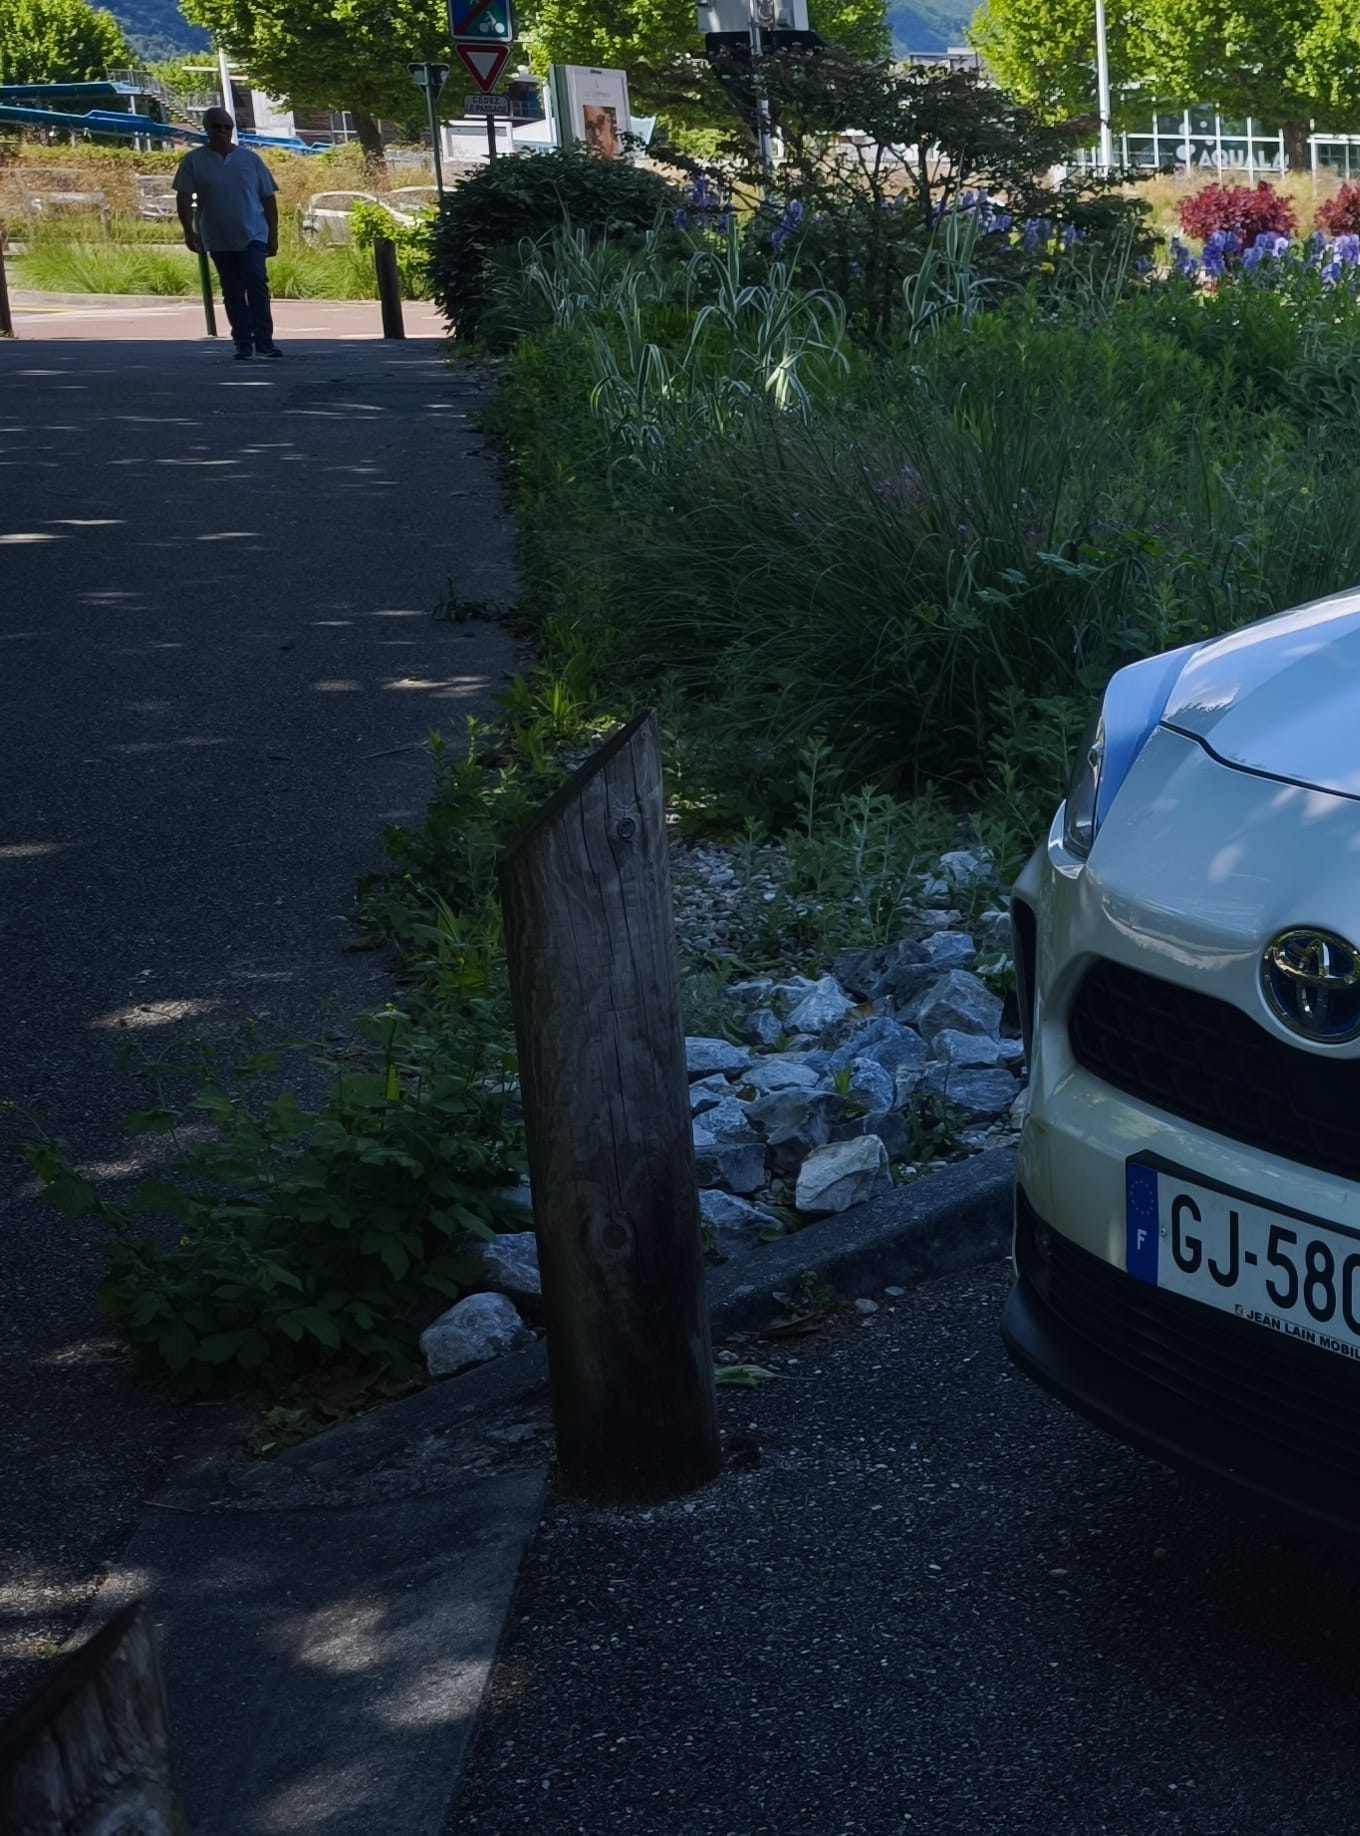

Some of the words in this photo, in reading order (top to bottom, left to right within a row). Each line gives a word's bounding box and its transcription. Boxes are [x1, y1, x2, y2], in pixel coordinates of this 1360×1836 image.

[1136, 1228, 1147, 1250] F
[1246, 1310, 1281, 1330] JEAN
[1284, 1323, 1316, 1343] LAIN
